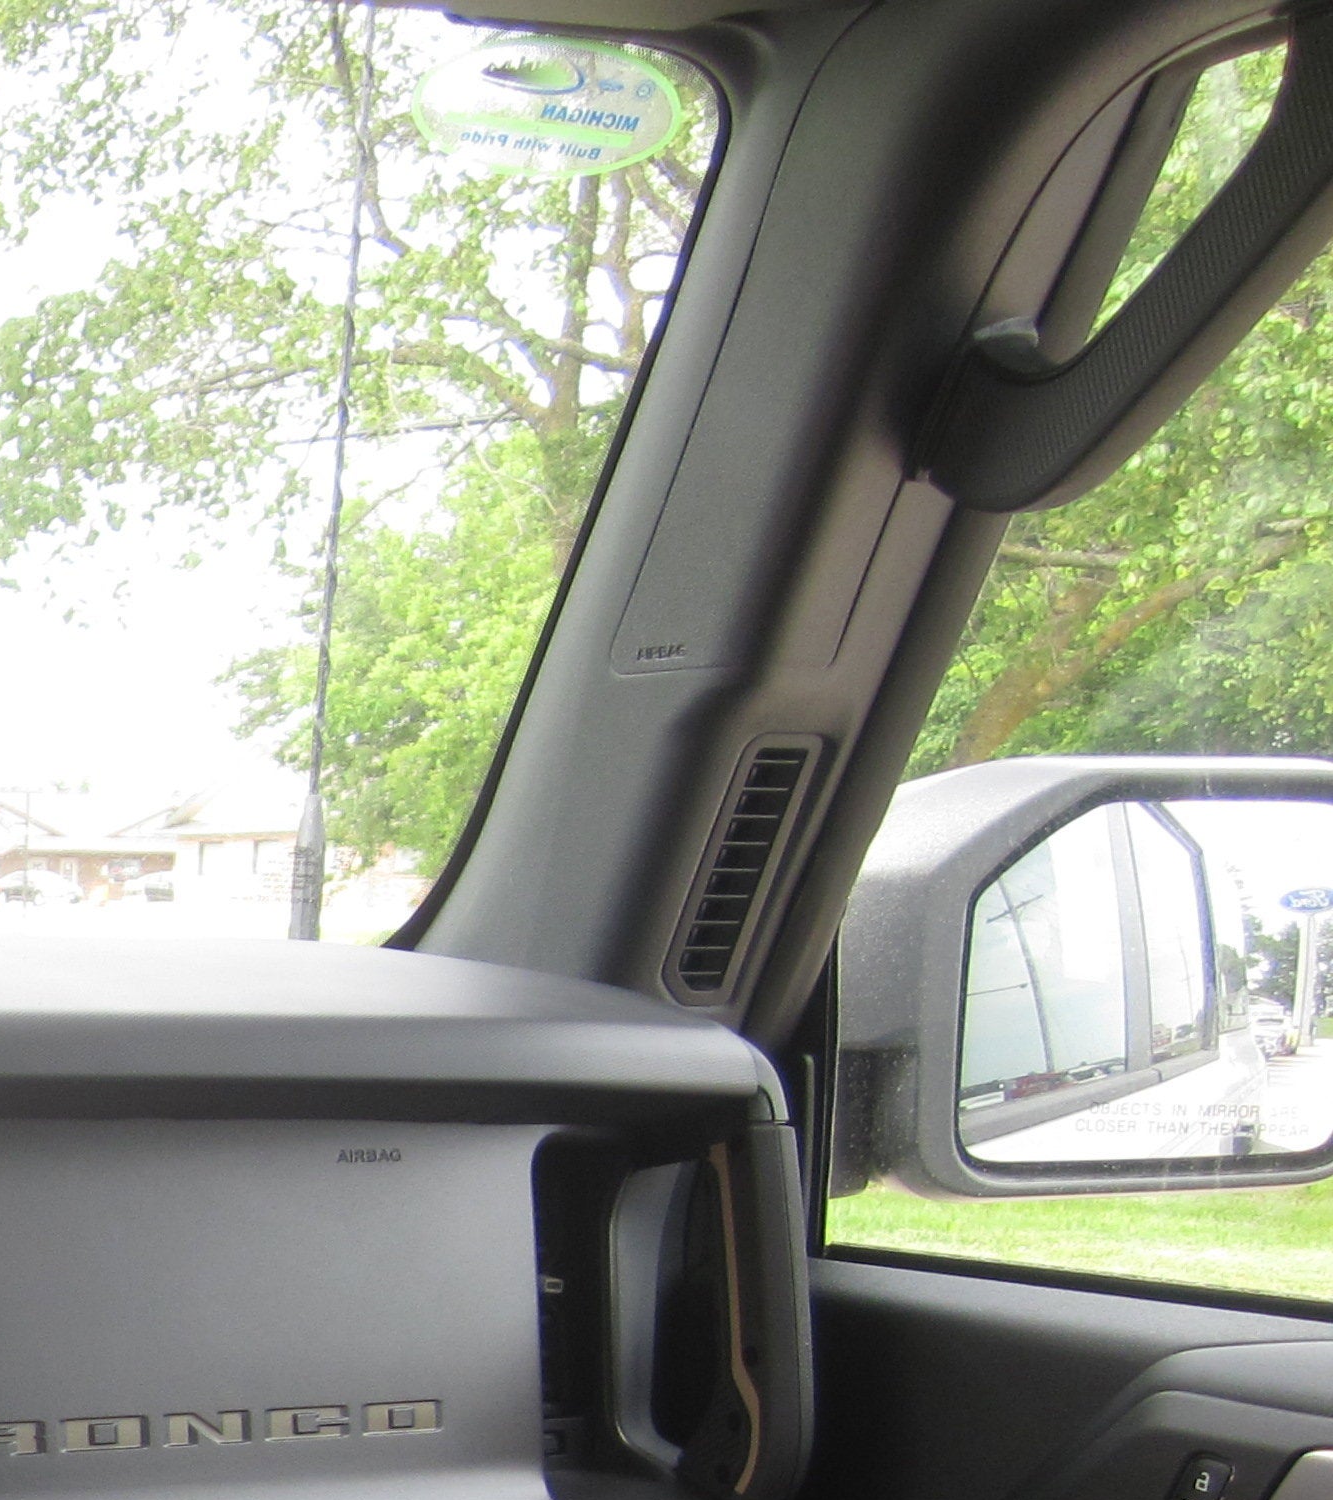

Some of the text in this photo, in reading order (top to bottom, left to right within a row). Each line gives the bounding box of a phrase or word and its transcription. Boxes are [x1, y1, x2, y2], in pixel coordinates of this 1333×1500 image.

[1089, 1102, 1162, 1117] OBJECTS
[1172, 1103, 1187, 1117] IN
[1198, 1104, 1261, 1120] MIRROR
[1074, 1118, 1137, 1133] CLOSER
[1149, 1120, 1190, 1135] THAN
[336, 1148, 403, 1164] AIRBAG
